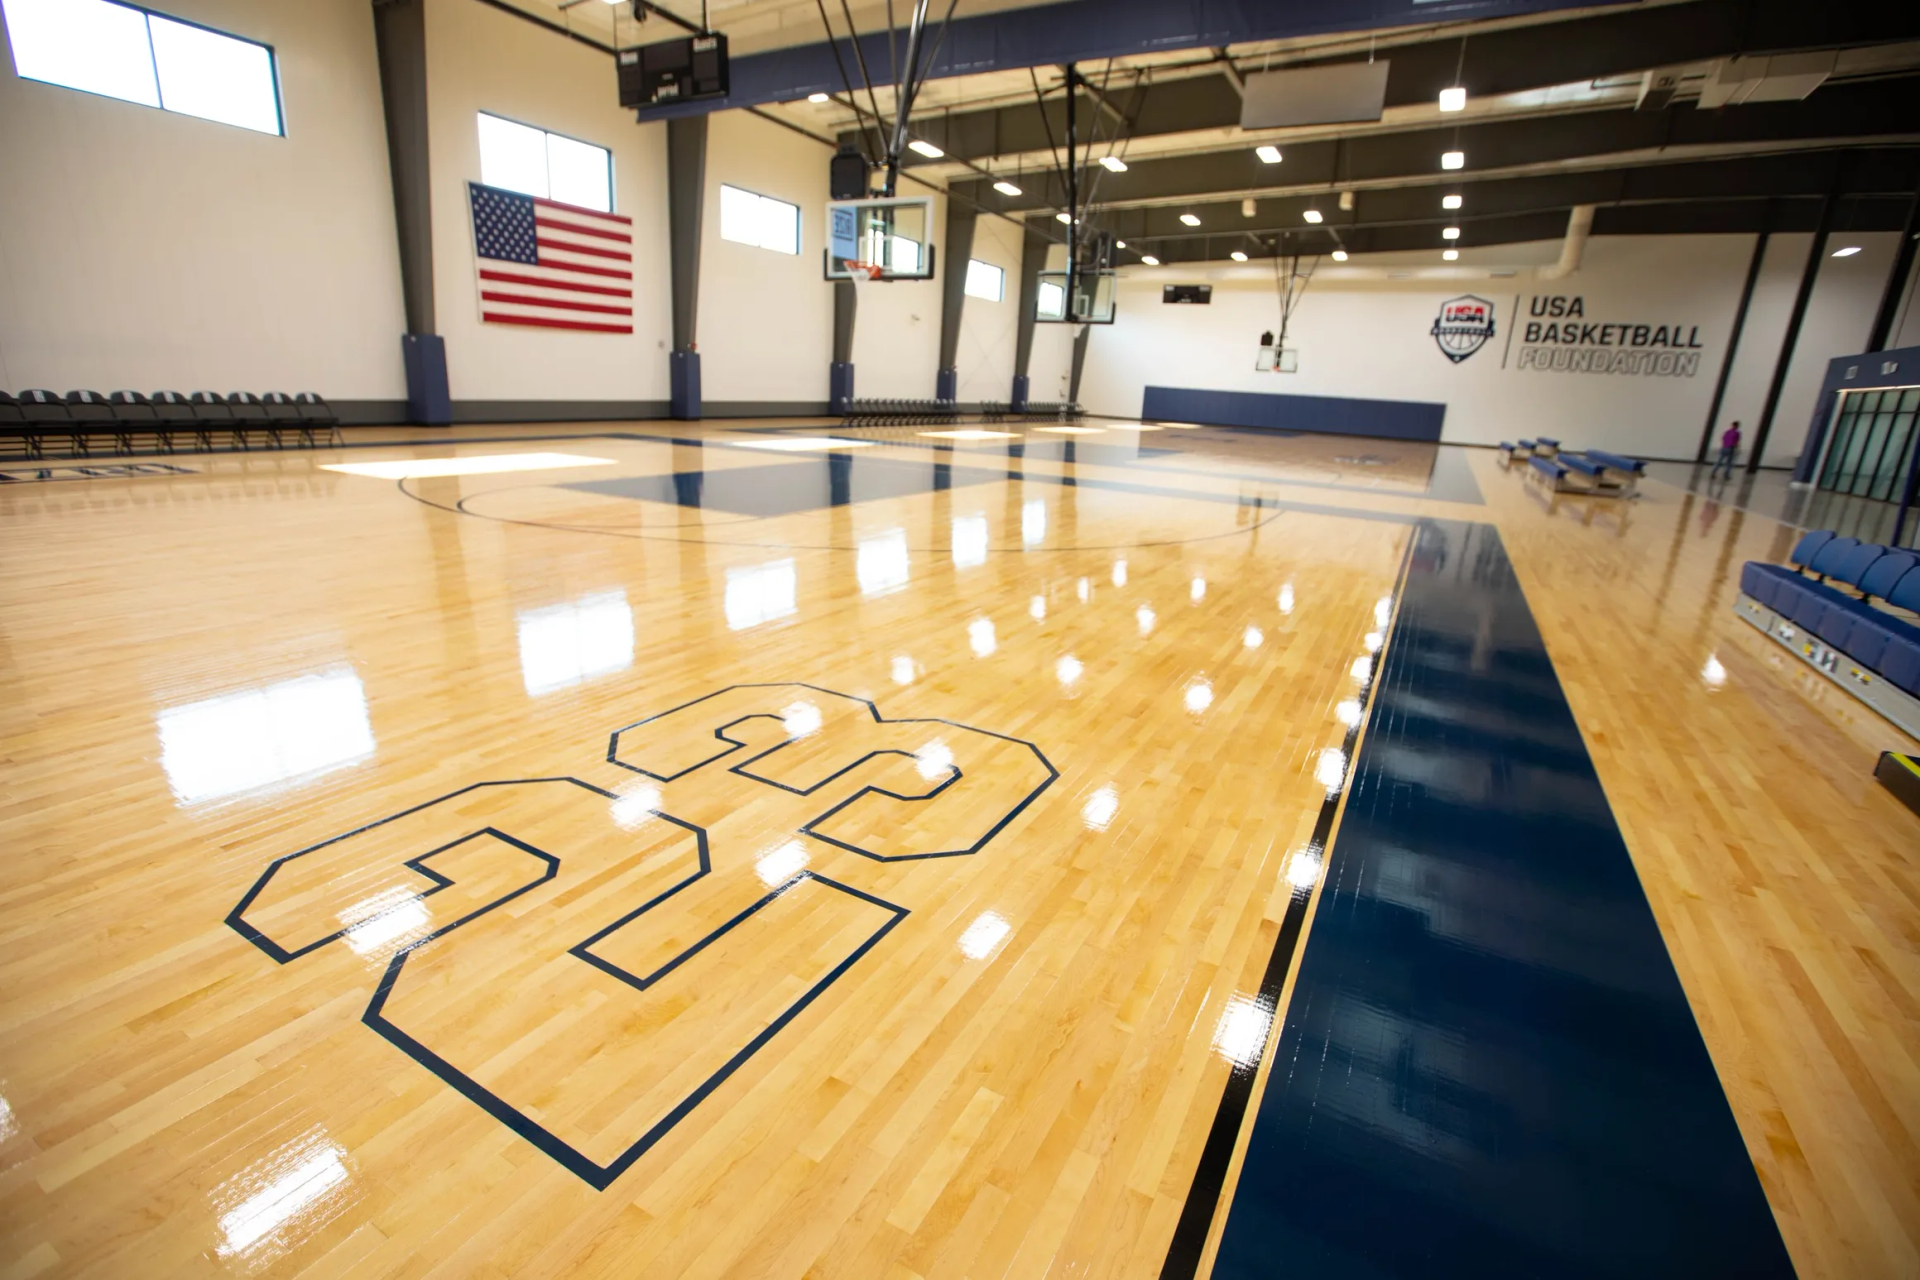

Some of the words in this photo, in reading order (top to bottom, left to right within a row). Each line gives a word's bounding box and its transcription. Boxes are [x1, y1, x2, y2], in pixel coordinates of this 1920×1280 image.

[1445, 304, 1485, 323] USA
[1530, 295, 1585, 318] USA
[1524, 322, 1703, 348] BASKETBALL
[1516, 346, 1701, 378] FOUNDATION
